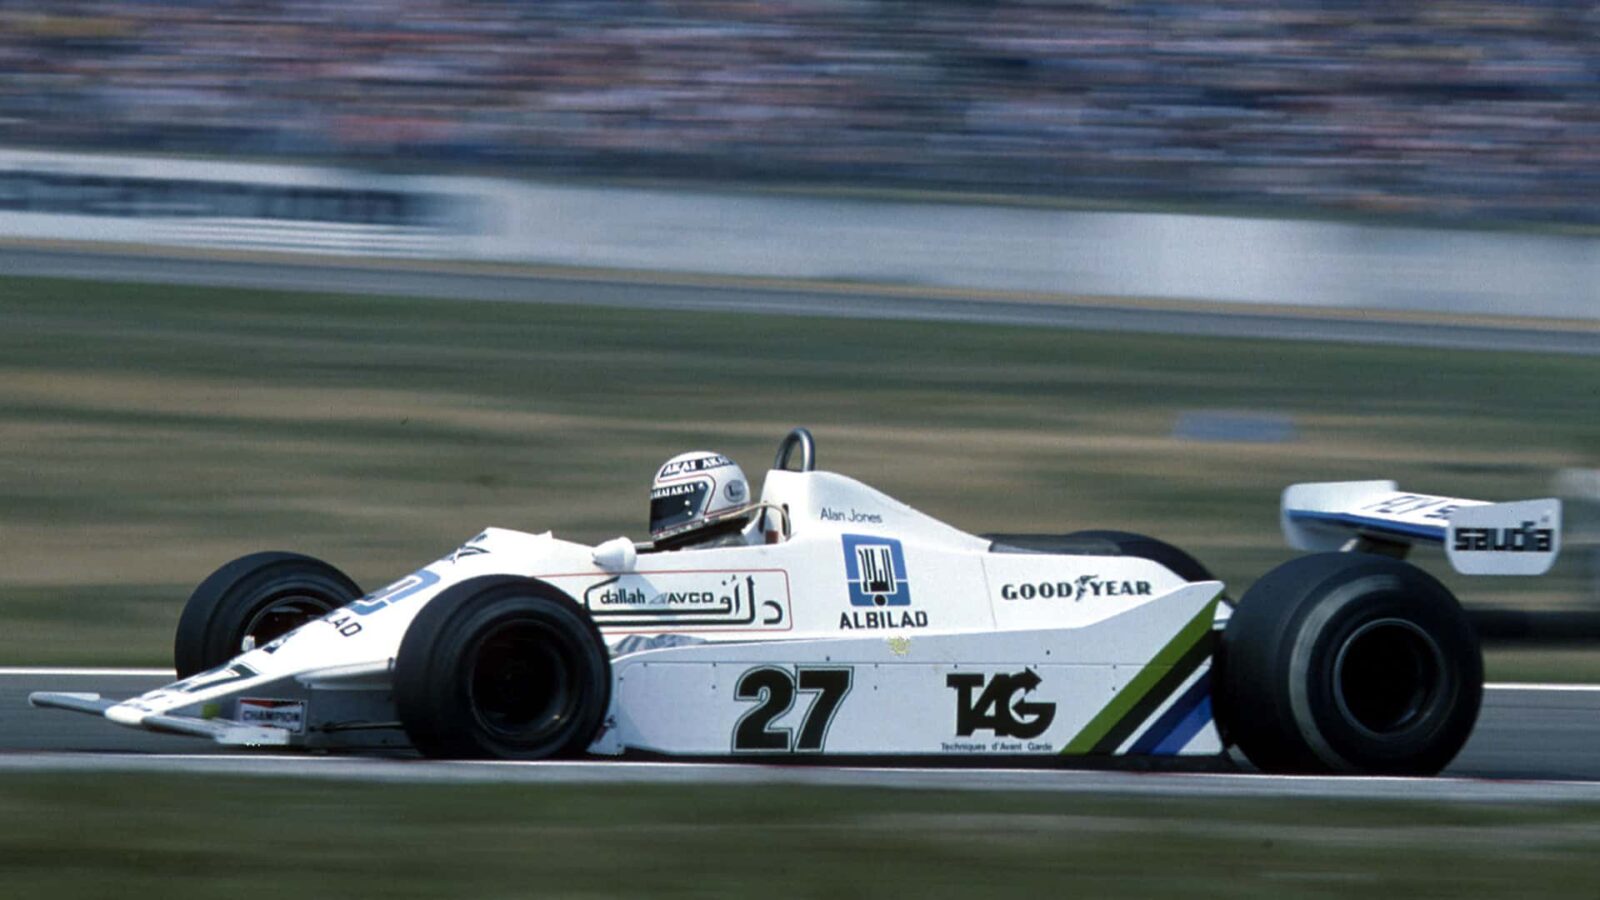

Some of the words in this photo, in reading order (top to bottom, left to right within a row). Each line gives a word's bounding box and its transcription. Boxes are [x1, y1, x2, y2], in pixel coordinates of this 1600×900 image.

[671, 483, 695, 496] AKAI
[820, 507, 845, 521] Alan
[848, 509, 883, 523] Jones
[600, 588, 646, 605] dallah
[839, 610, 928, 630] ALBILAD
[731, 664, 854, 753] 27
[946, 665, 1056, 740] TAG
[941, 742, 986, 752] Techniques
[1027, 742, 1053, 751] Garde
